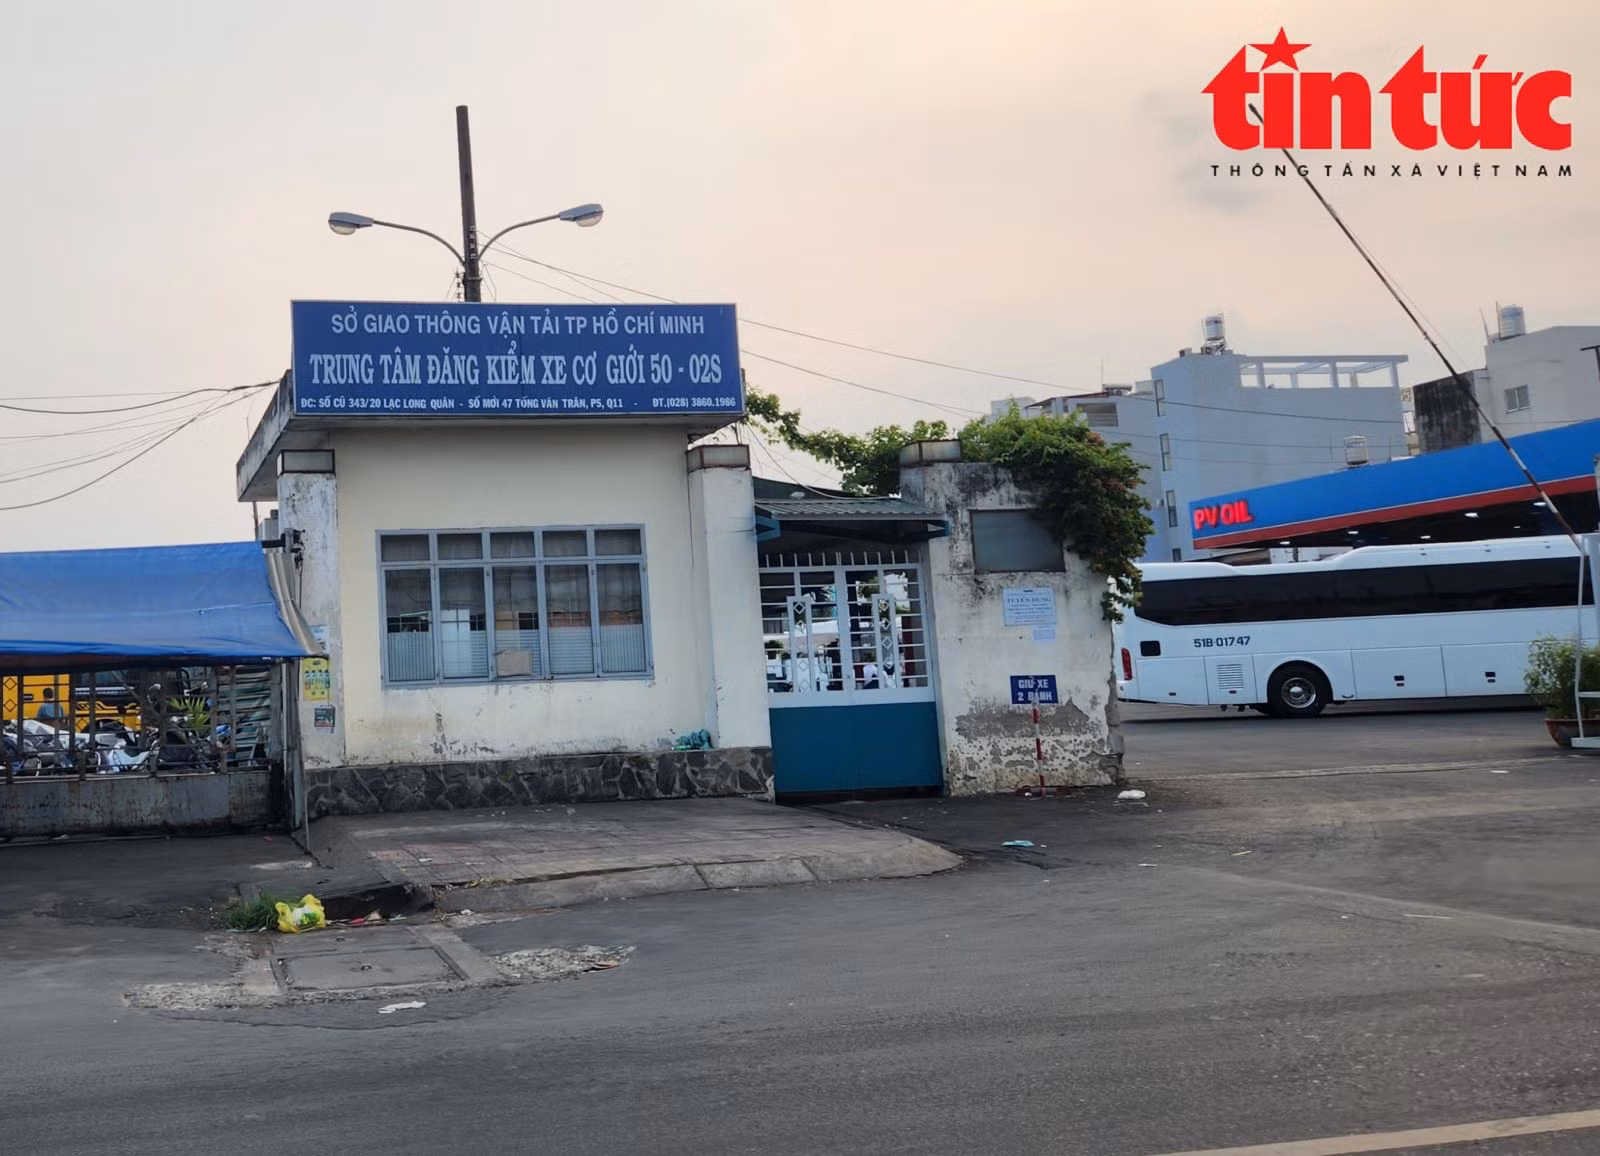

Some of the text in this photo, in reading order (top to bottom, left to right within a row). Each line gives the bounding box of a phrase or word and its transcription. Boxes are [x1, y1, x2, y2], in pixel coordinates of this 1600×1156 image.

[331, 305, 704, 338] SỞ GIAO THÔNG VẬN TẢI TP HỒ CHÍ MINH
[310, 353, 374, 384] TRUNG
[379, 346, 421, 384] TÂM
[427, 347, 479, 385] ĐĂNG
[487, 340, 536, 384] KIỂM
[541, 355, 567, 384] XE
[572, 351, 598, 385] CƠ
[606, 344, 645, 384] GIỚI
[651, 352, 672, 384] 50
[689, 353, 722, 384] 02S
[318, 395, 331, 408] SỐ
[403, 399, 427, 409] LONG
[468, 395, 481, 408] SỐ
[501, 399, 513, 408] 47
[590, 398, 605, 410] P5,
[606, 398, 624, 409] Q11
[1193, 499, 1254, 530] PV OIL
[1037, 679, 1049, 689] XE
[1017, 692, 1024, 702] 2
